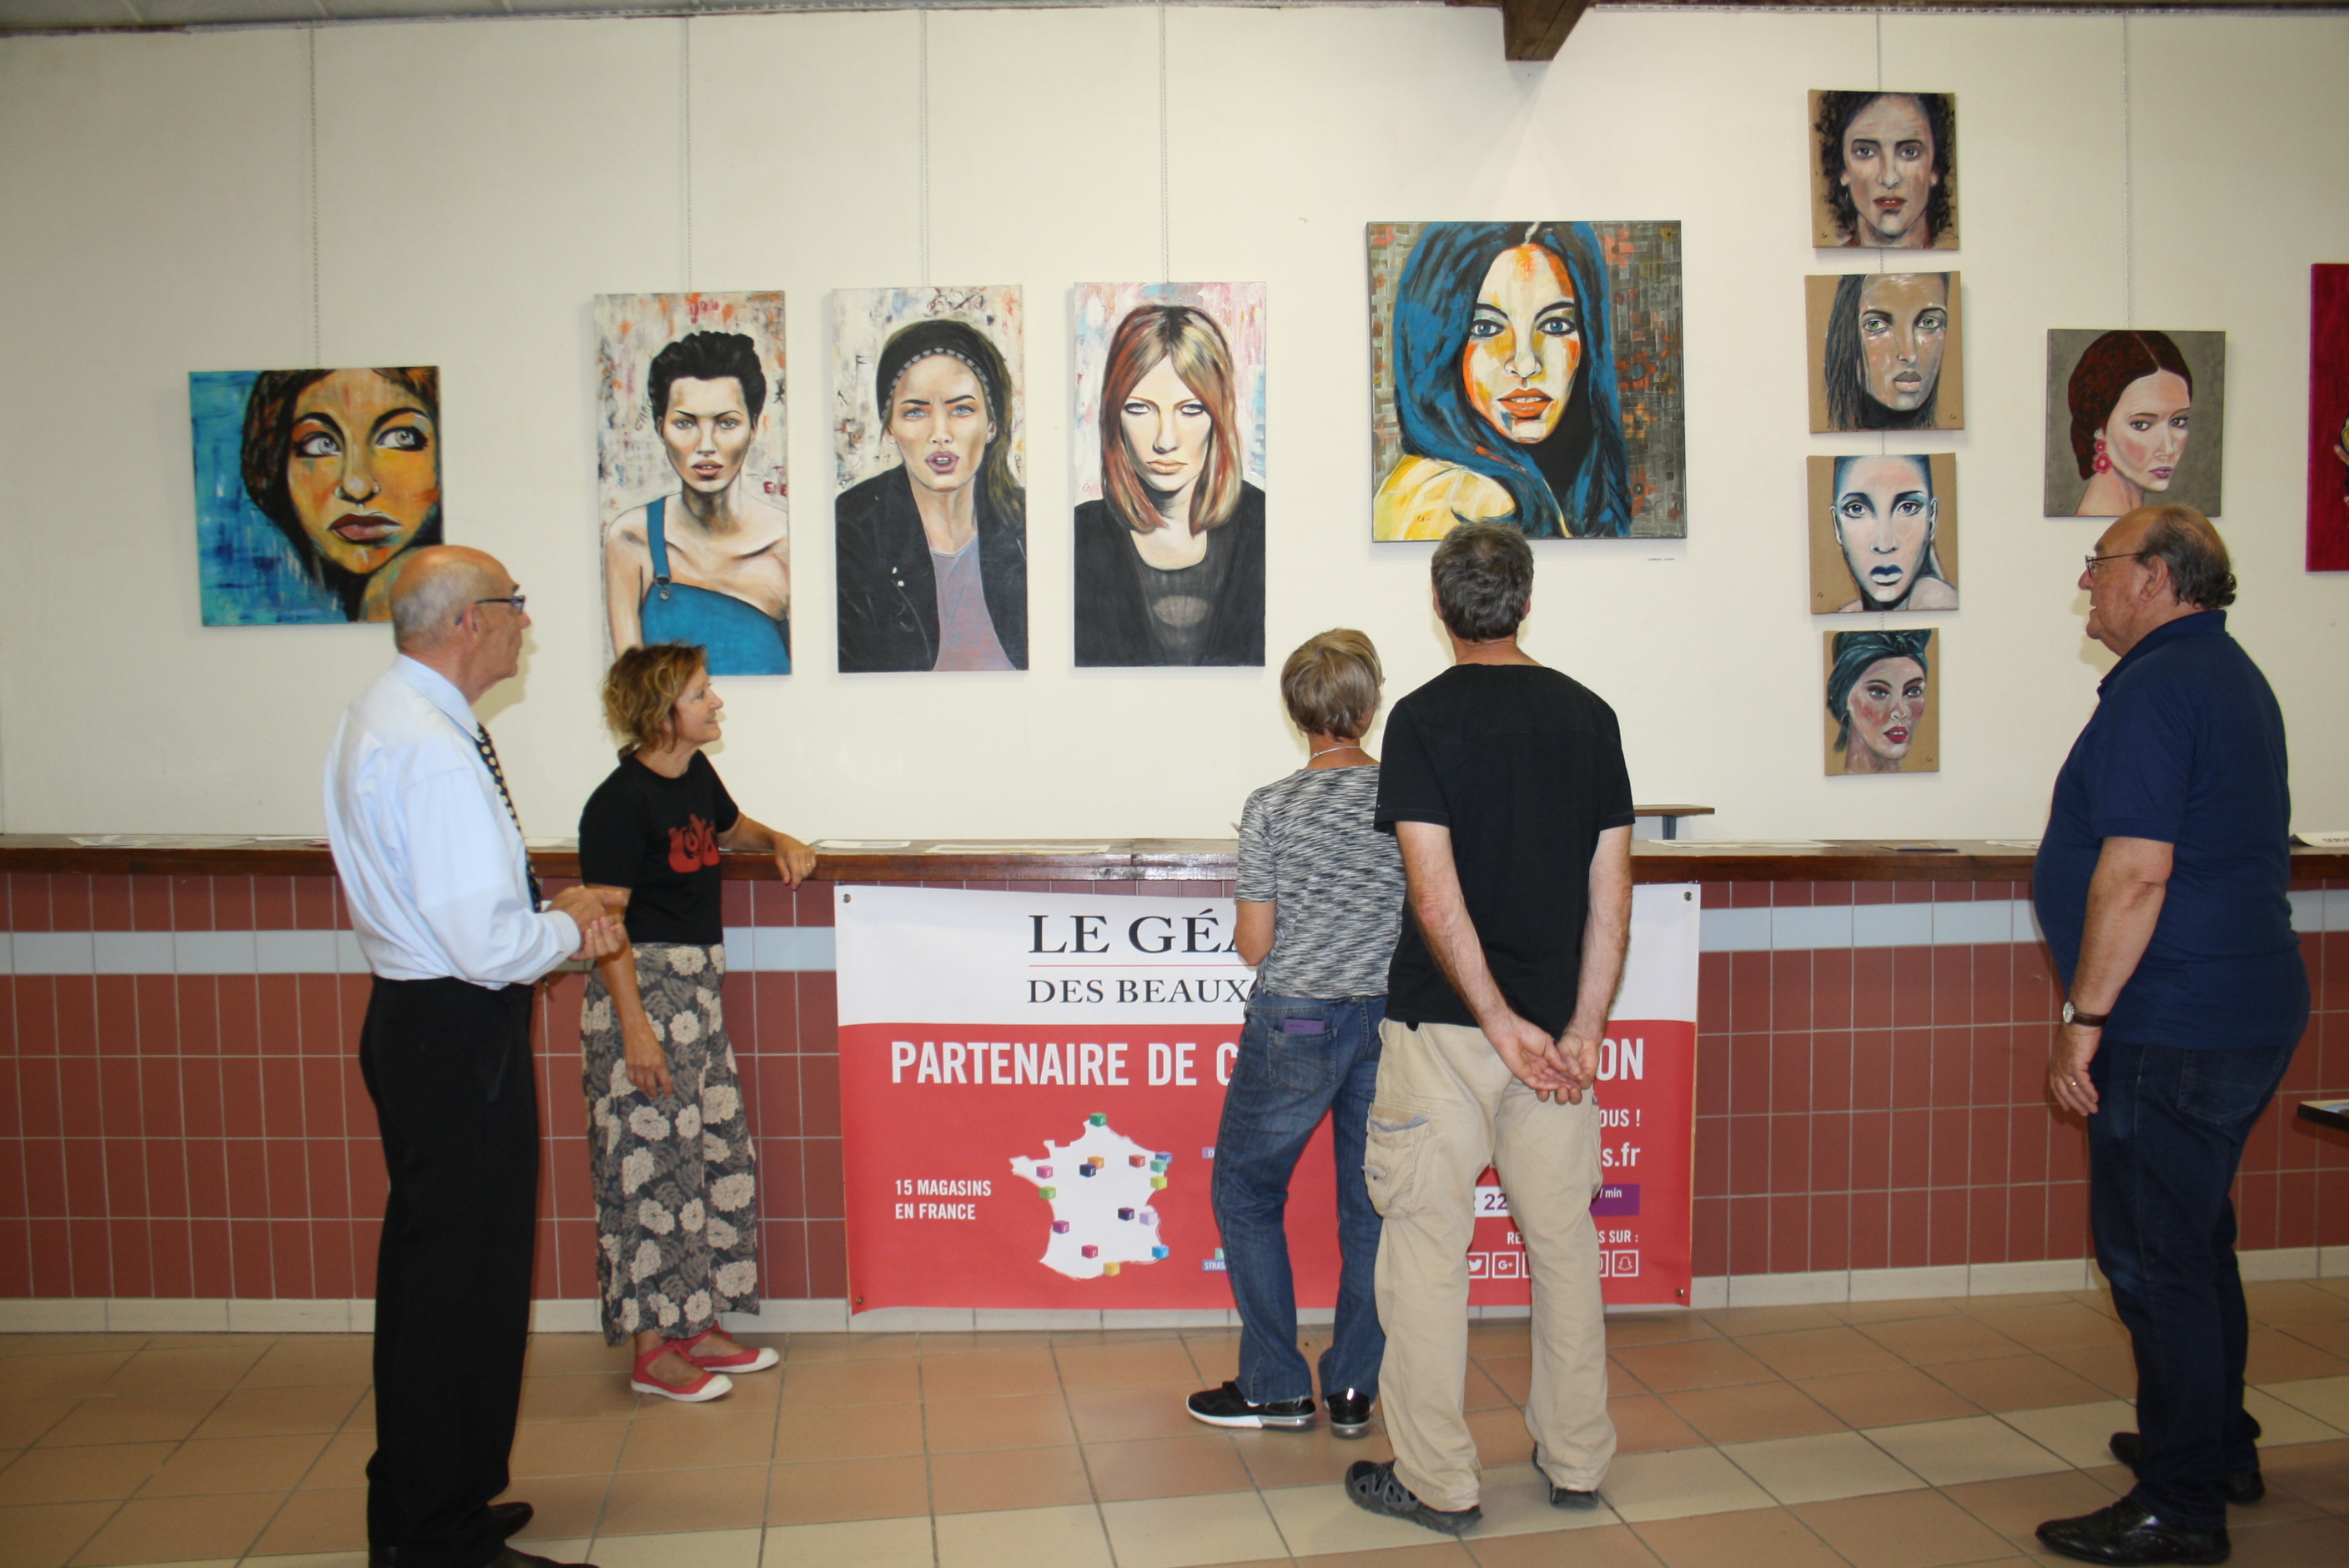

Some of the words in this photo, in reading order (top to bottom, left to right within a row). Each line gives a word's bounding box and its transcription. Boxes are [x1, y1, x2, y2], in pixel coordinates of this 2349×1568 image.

[1029, 915, 1109, 953] LE
[1028, 979, 1104, 1003] DES
[1116, 979, 1250, 1003] BEAUX
[892, 1041, 1129, 1086] PARTENAIRE
[1148, 1042, 1197, 1086] DE
[895, 1179, 913, 1196] 15
[917, 1179, 992, 1197] MAGASINS
[1605, 1188, 1622, 1199] min
[895, 1204, 914, 1219] EN
[918, 1204, 976, 1220] FRANCE
[1506, 1231, 1524, 1245] RE
[1609, 1230, 1632, 1244] SUR
[1204, 1261, 1227, 1270] STRAS
